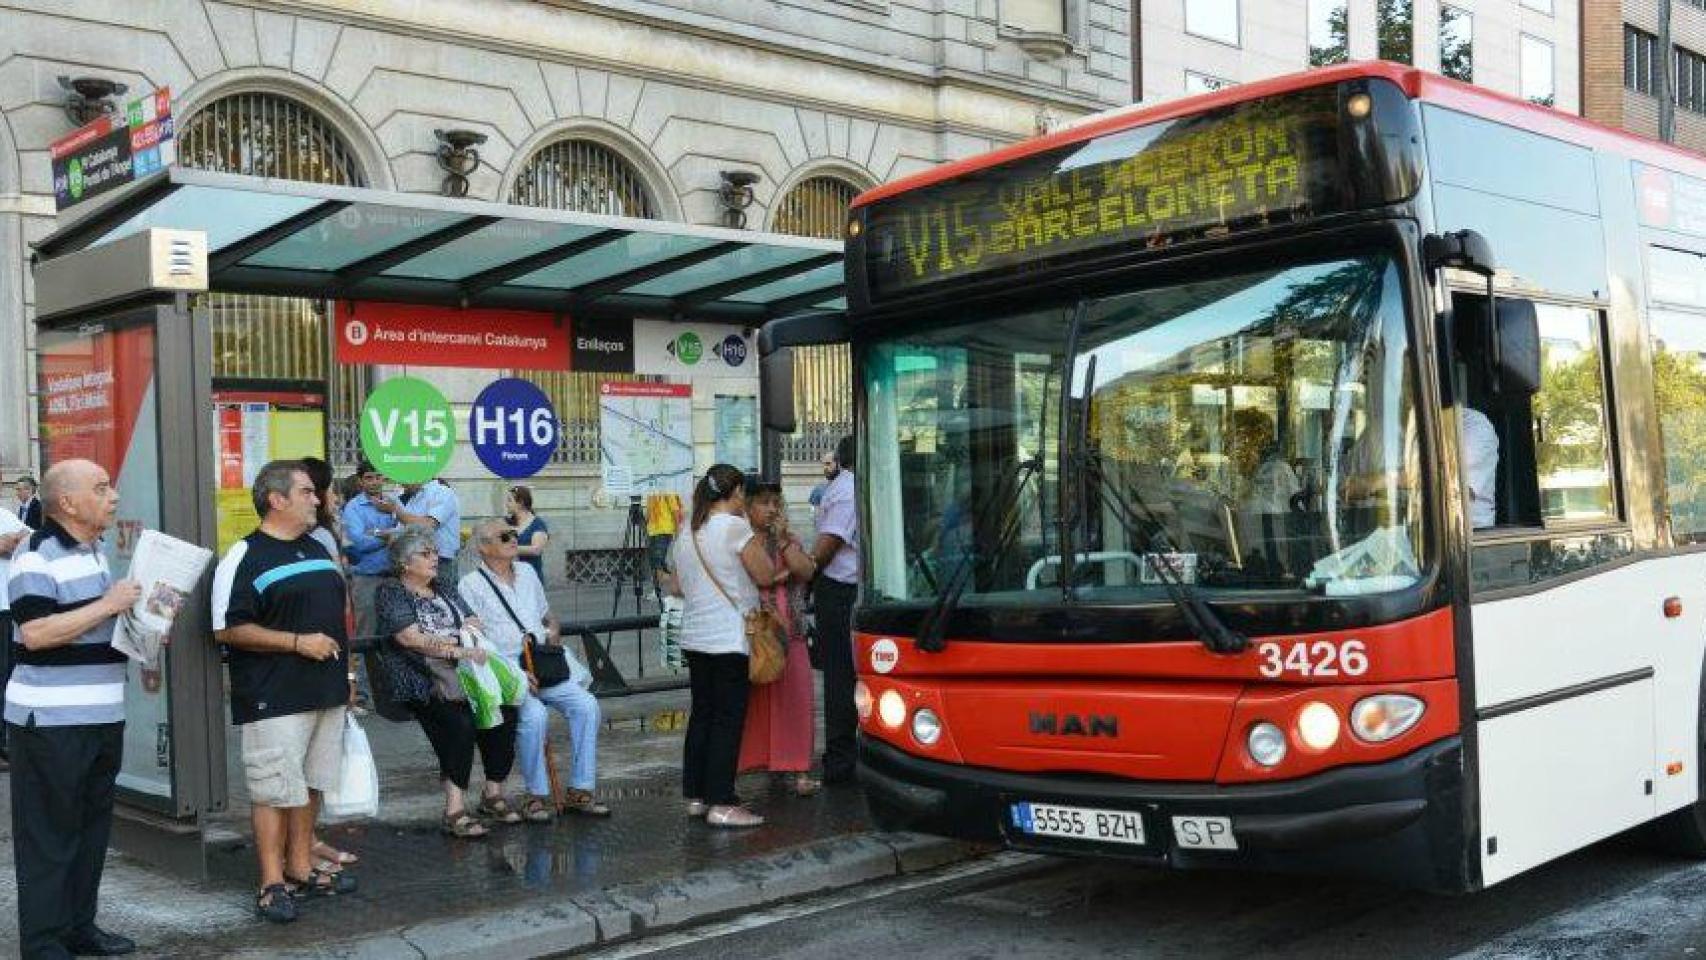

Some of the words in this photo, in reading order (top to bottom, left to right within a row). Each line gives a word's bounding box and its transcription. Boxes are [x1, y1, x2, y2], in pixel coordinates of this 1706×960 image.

[901, 202, 983, 278] V15
[987, 155, 1298, 253] BARCELONETA
[373, 326, 405, 342] Àrea
[407, 328, 483, 346] d'intercanvi
[484, 332, 548, 351] Catalunya
[576, 336, 624, 354] Enlaços
[679, 340, 701, 355] V15
[723, 343, 746, 358] H16
[367, 407, 449, 448] V15
[475, 407, 554, 446] H16
[1258, 640, 1370, 677] 3426
[1029, 711, 1118, 738] MAN
[1034, 807, 1086, 835] 5555
[1096, 813, 1138, 840] BZH
[1181, 819, 1225, 846] SP
